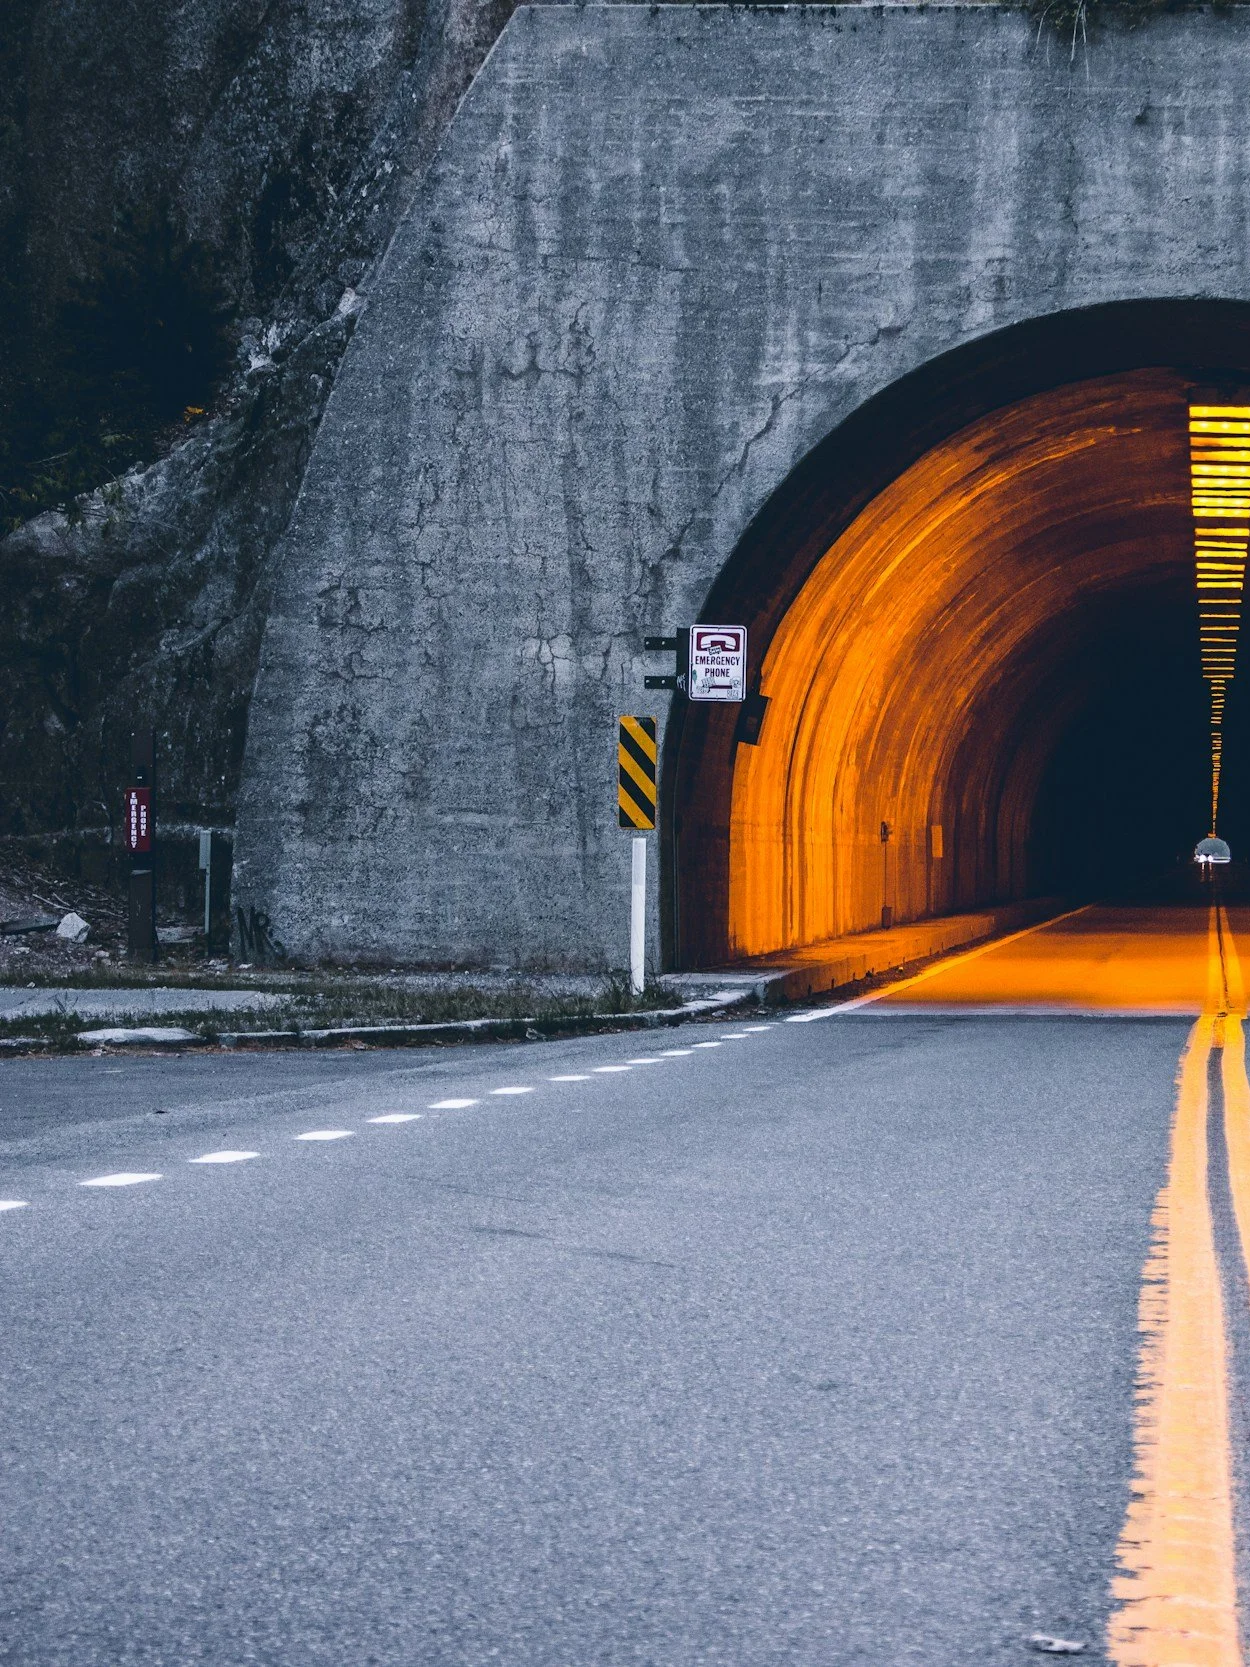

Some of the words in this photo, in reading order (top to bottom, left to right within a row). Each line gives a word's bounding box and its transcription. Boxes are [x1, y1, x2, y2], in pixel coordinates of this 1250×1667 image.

[695, 656, 740, 666] EMERGENCY
[705, 668, 730, 677] PHONE
[130, 792, 138, 848] EMERGENCY
